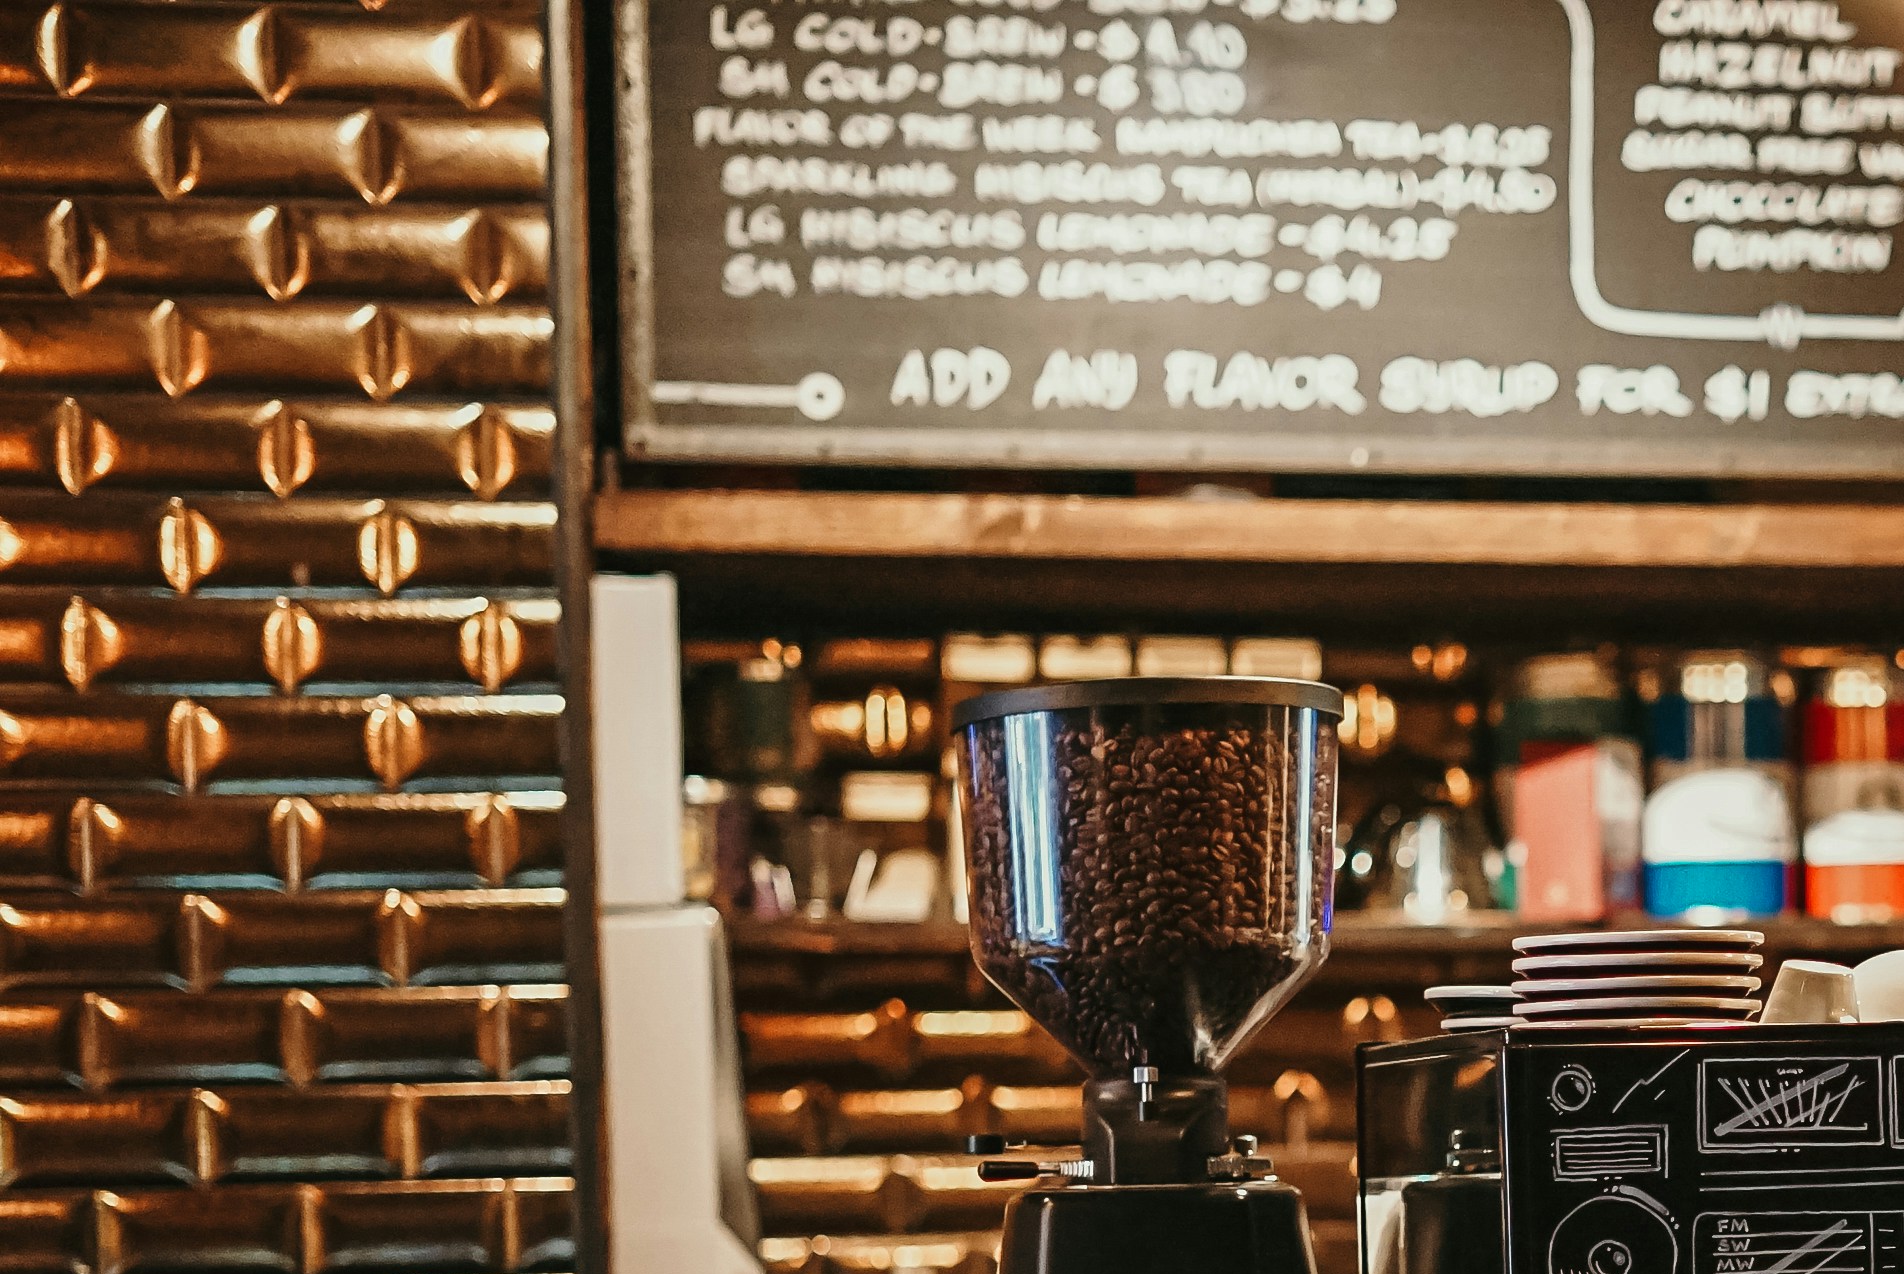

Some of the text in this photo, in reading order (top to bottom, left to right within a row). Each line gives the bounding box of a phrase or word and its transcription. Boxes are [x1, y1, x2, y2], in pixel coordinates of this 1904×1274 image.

[710, 5, 773, 52] LG
[1658, 39, 1904, 90] HAZELNUT
[725, 204, 785, 249] LG
[1692, 225, 1894, 273] PUMPKIN
[891, 345, 1011, 411] ADD
[1032, 348, 1138, 411] ANY
[1163, 349, 1366, 417] FLAVOR
[1576, 364, 1694, 418] FOR
[1717, 1218, 1749, 1233] FM
[1717, 1238, 1751, 1251] SW
[1717, 1257, 1755, 1271] MW
